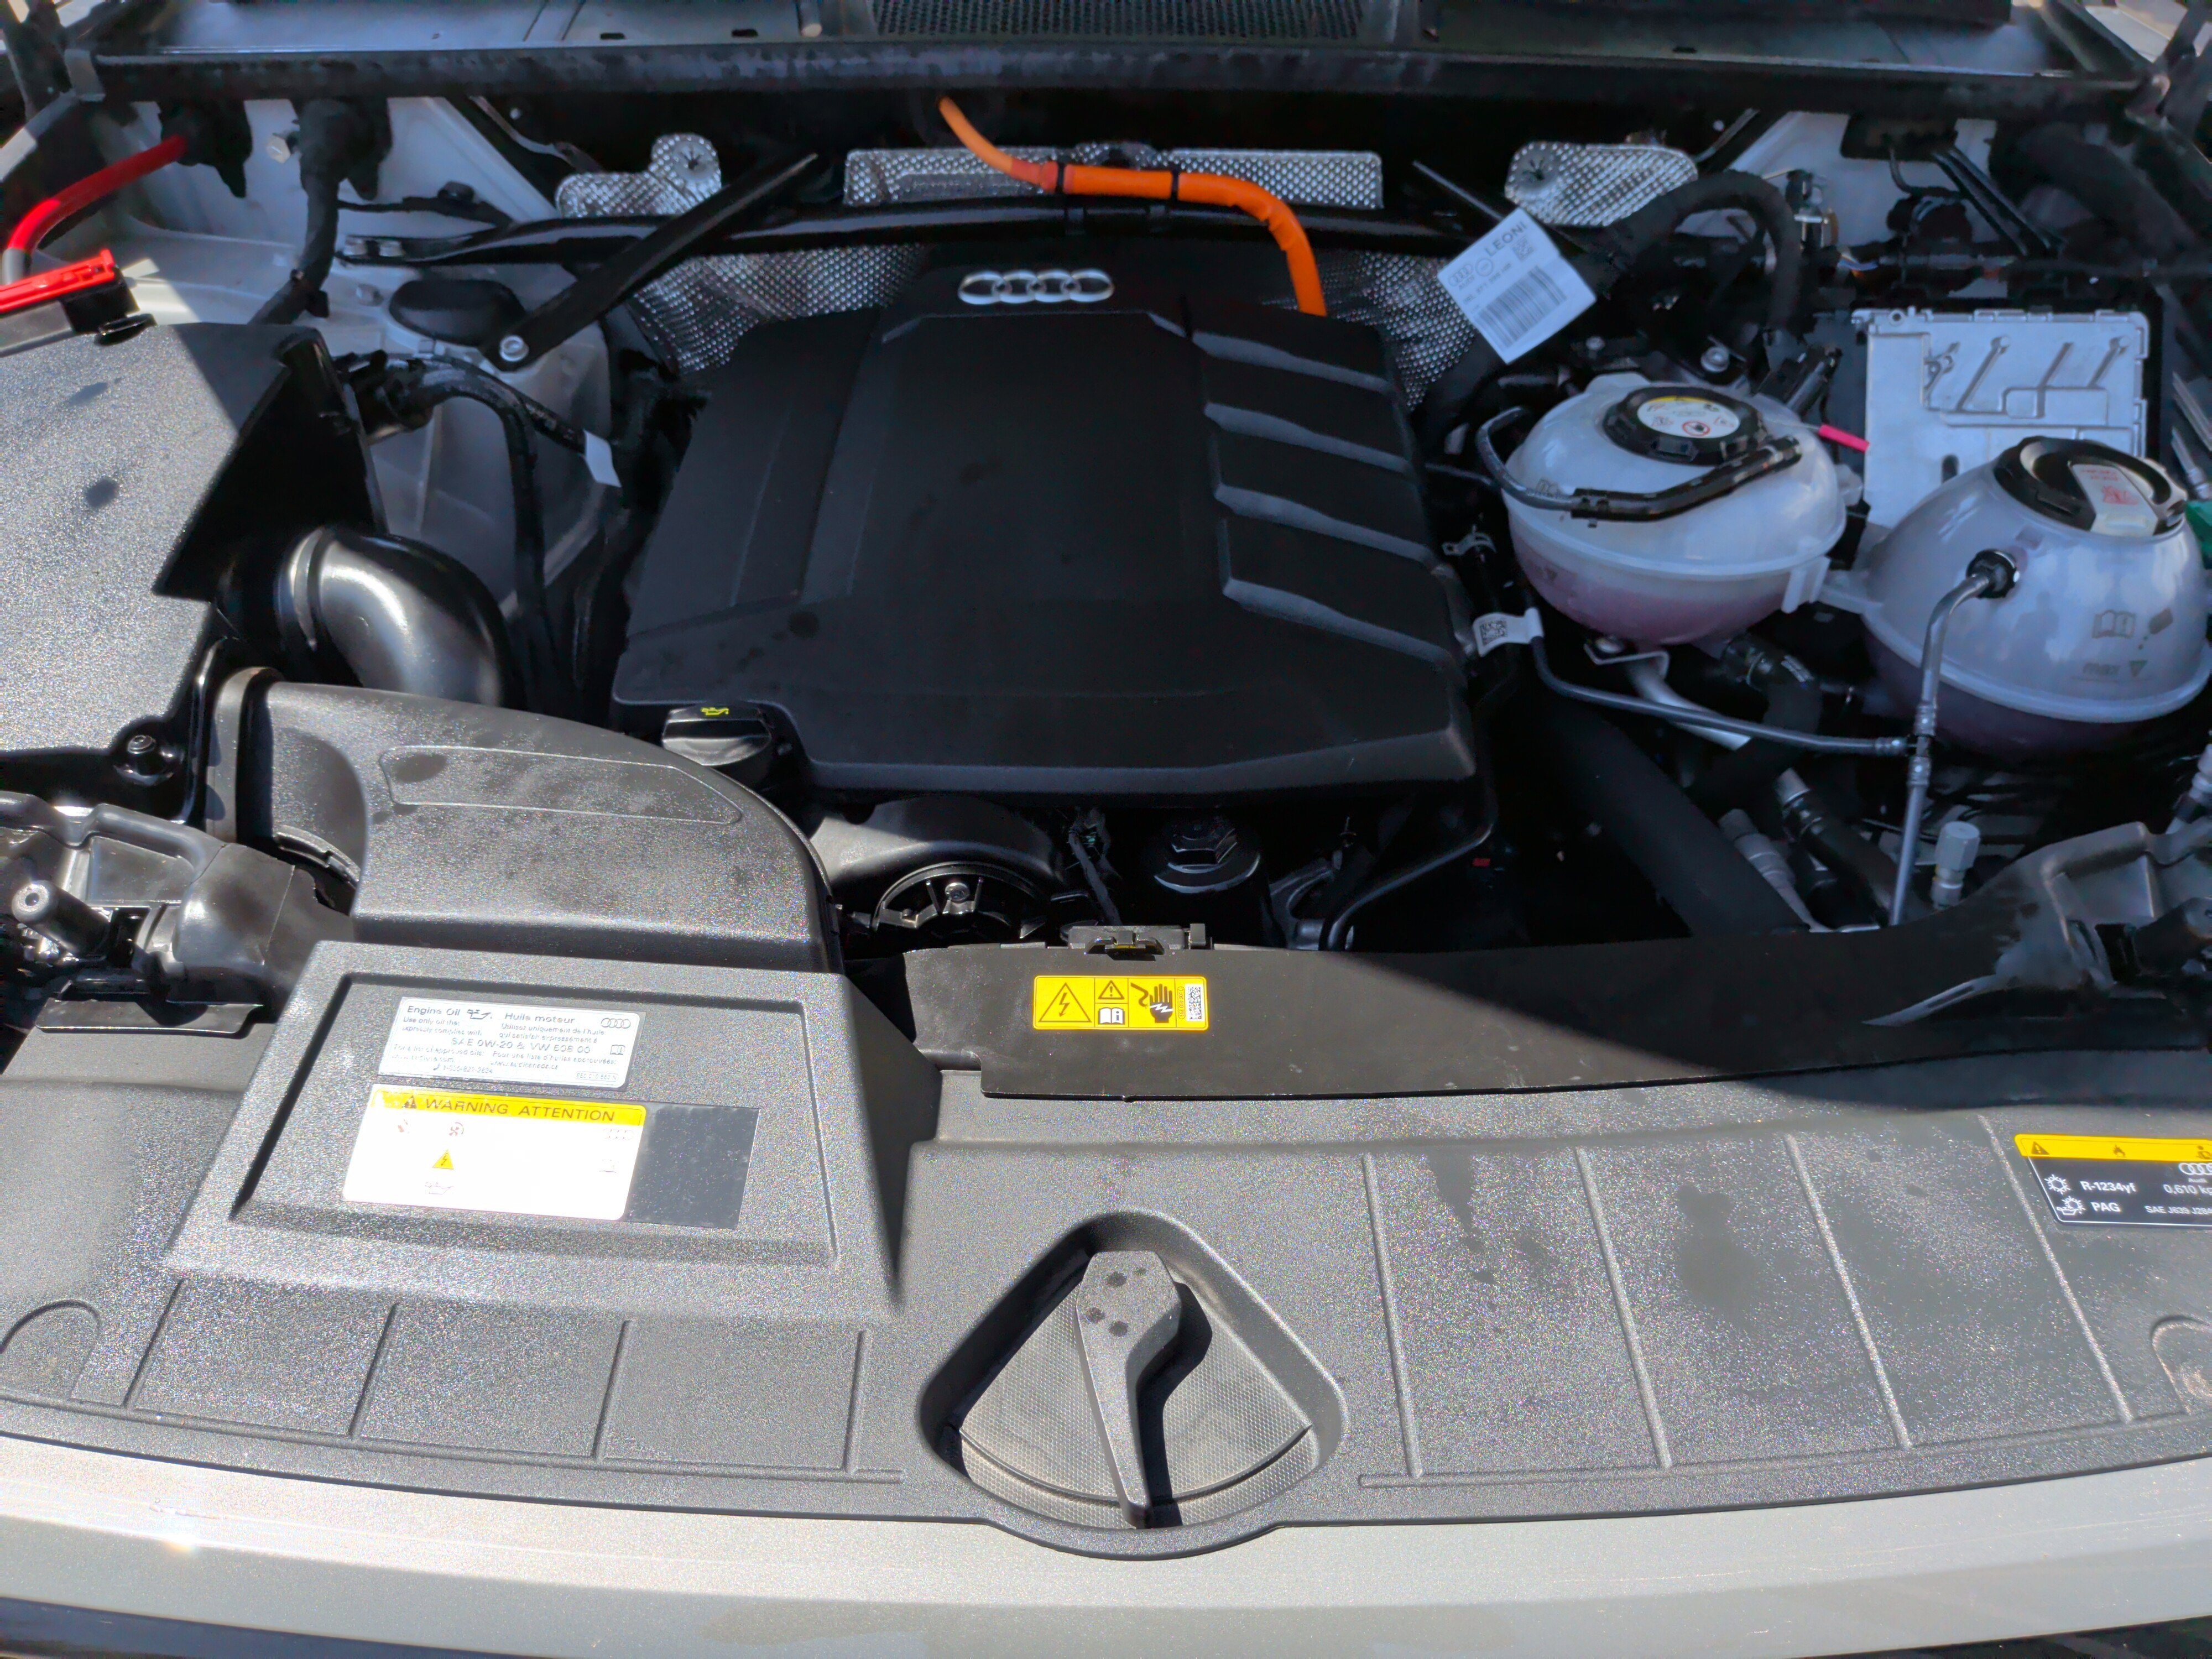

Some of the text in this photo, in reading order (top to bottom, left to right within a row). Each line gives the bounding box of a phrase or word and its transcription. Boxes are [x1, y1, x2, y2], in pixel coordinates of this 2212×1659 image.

[1485, 222, 1527, 257] LEONI
[407, 1005, 442, 1015] Engine
[504, 1013, 531, 1021] Huile
[528, 1025, 571, 1034] uniquement
[451, 1037, 473, 1046] SAE
[477, 1039, 513, 1049] 0W-20
[530, 1042, 551, 1051] VW
[577, 1046, 591, 1054] 00
[425, 1098, 615, 1122] WARNING ATTENTION
[2080, 1181, 2137, 1194] R-1234yf
[2090, 1201, 2121, 1213] PAG
[2144, 1206, 2167, 1214] SAE
[2167, 1206, 2191, 1215] J639
